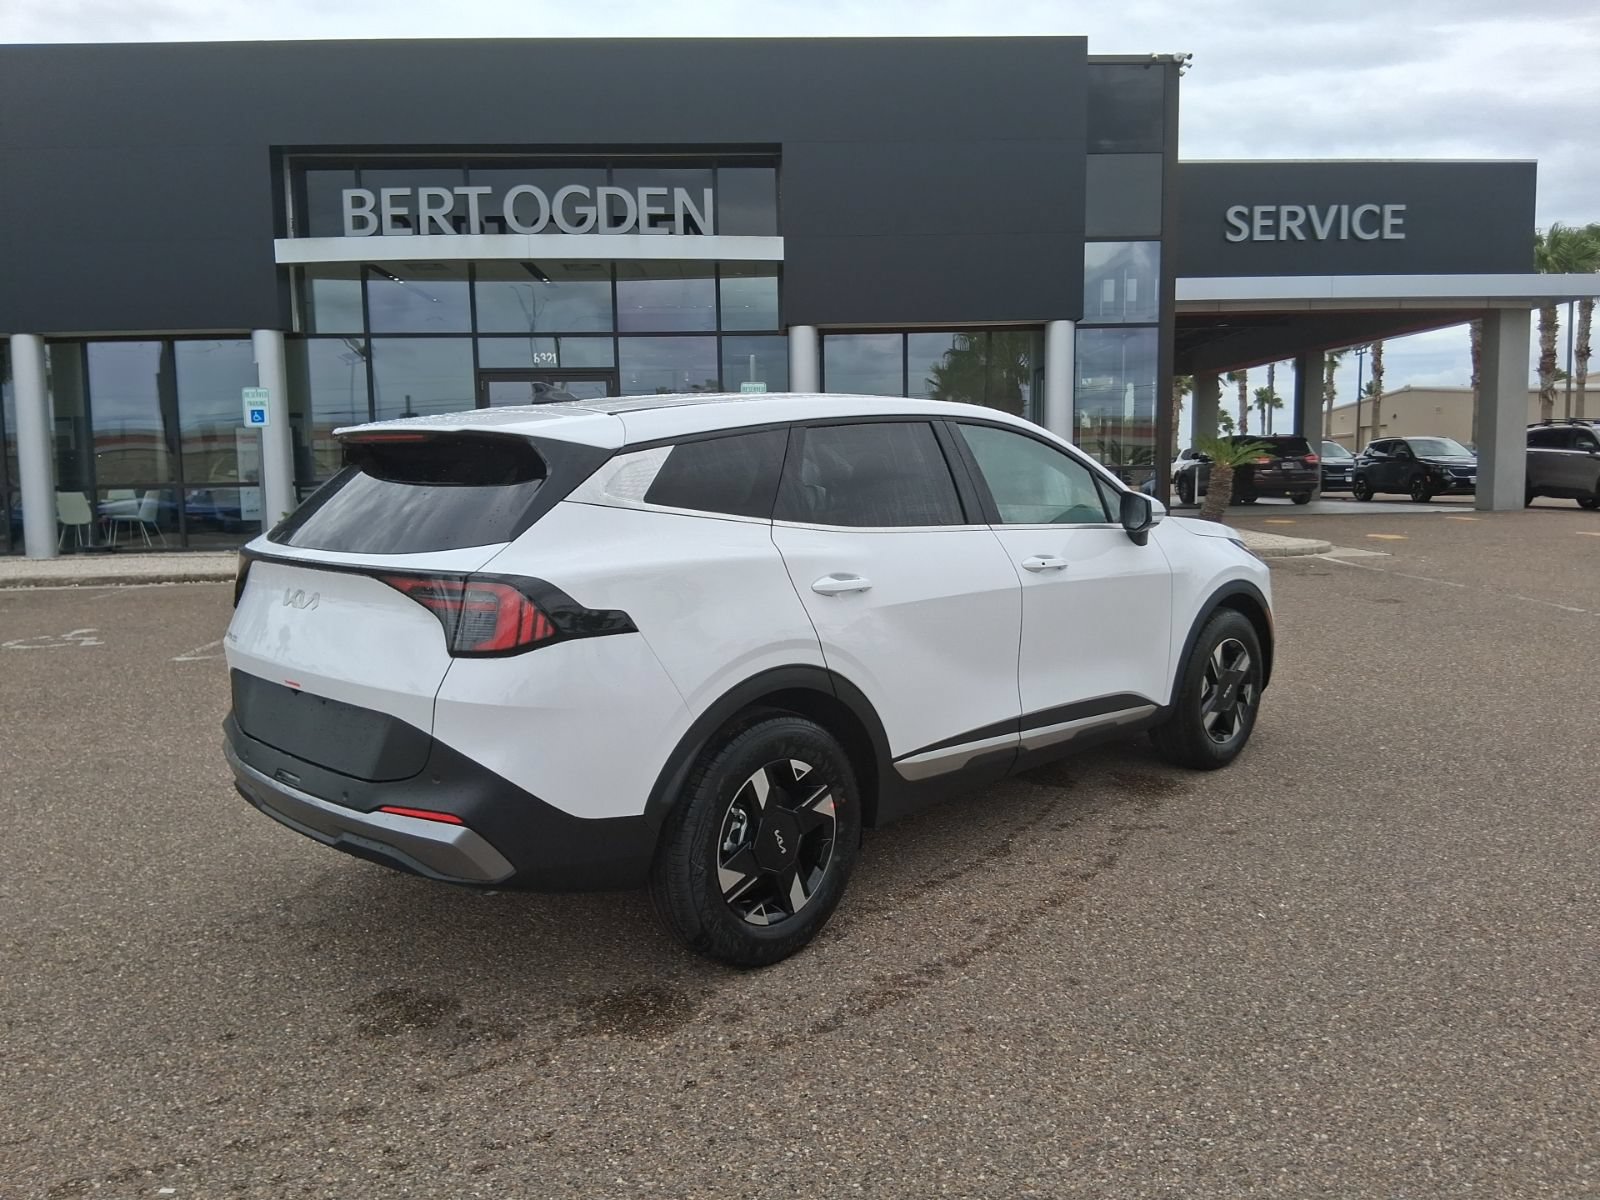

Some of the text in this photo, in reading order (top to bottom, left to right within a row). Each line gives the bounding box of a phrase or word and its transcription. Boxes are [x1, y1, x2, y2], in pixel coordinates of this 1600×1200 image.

[342, 184, 714, 236] BERT OGDEN
[1225, 204, 1407, 242] SERVICE
